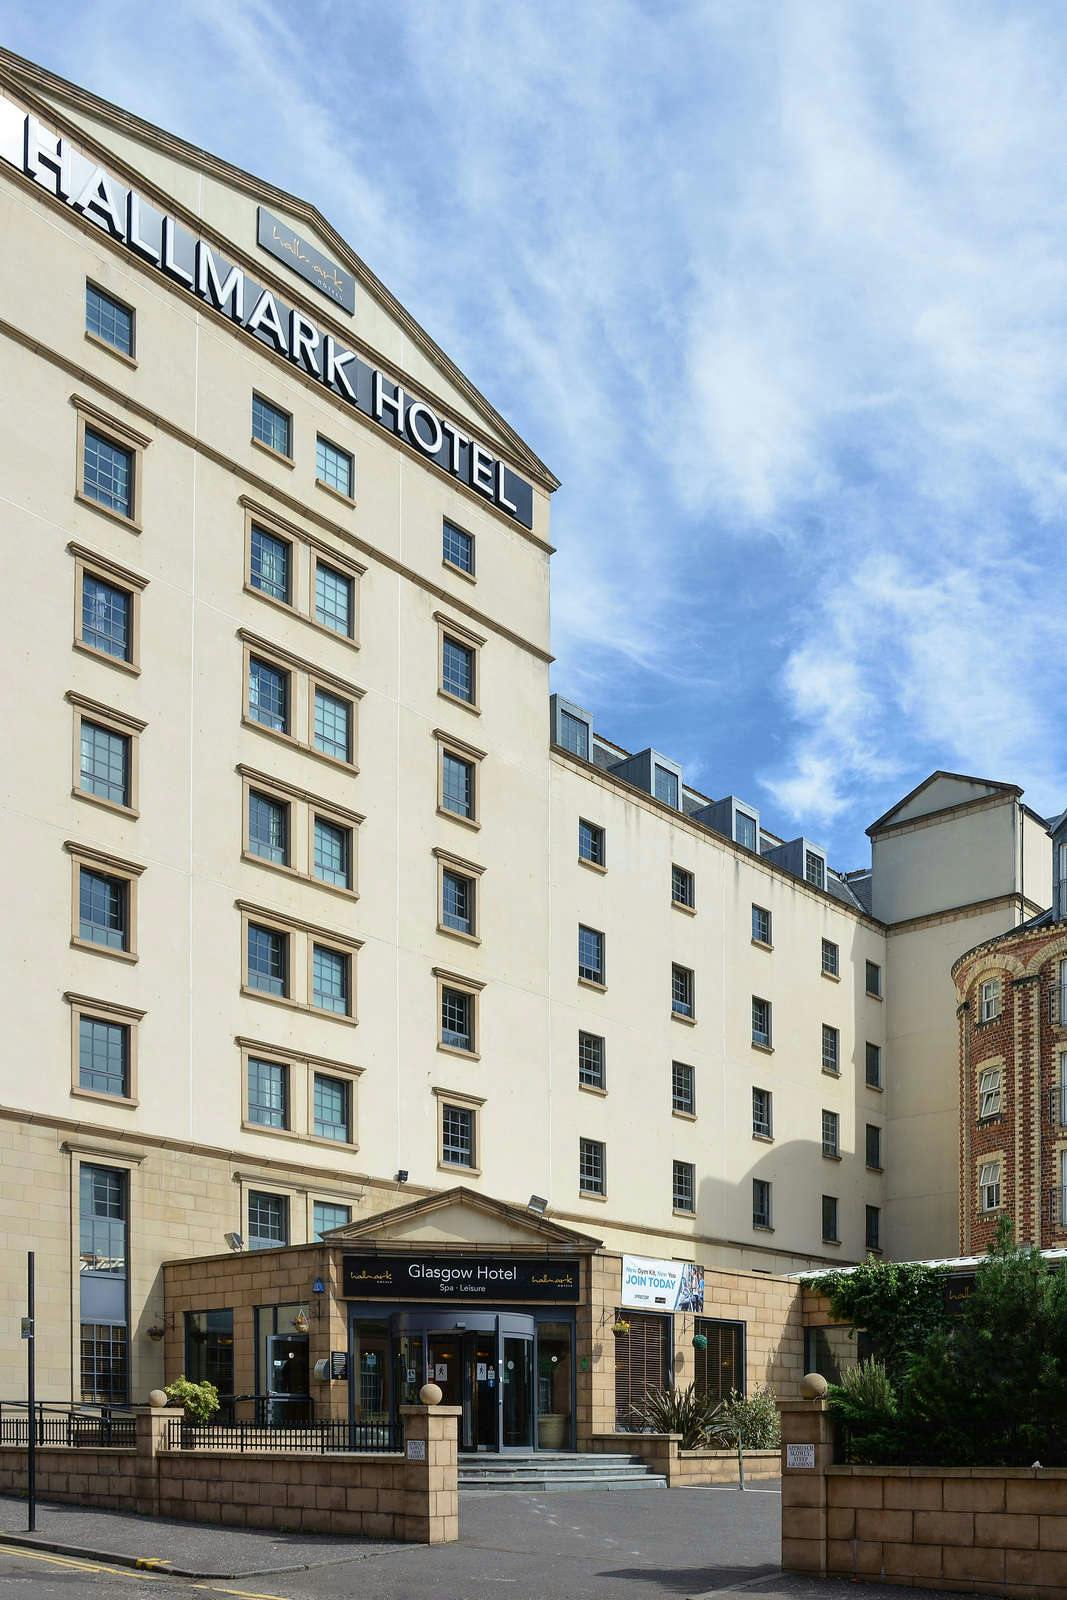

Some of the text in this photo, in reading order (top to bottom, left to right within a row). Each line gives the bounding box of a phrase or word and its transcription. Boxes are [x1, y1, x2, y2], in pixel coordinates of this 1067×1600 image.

[24, 113, 517, 515] HALLMARK HOTEL
[408, 1264, 517, 1282] Glasgow Hotel
[440, 1284, 486, 1292] Spa Leisure
[626, 1275, 676, 1290] JOIN TODAY
